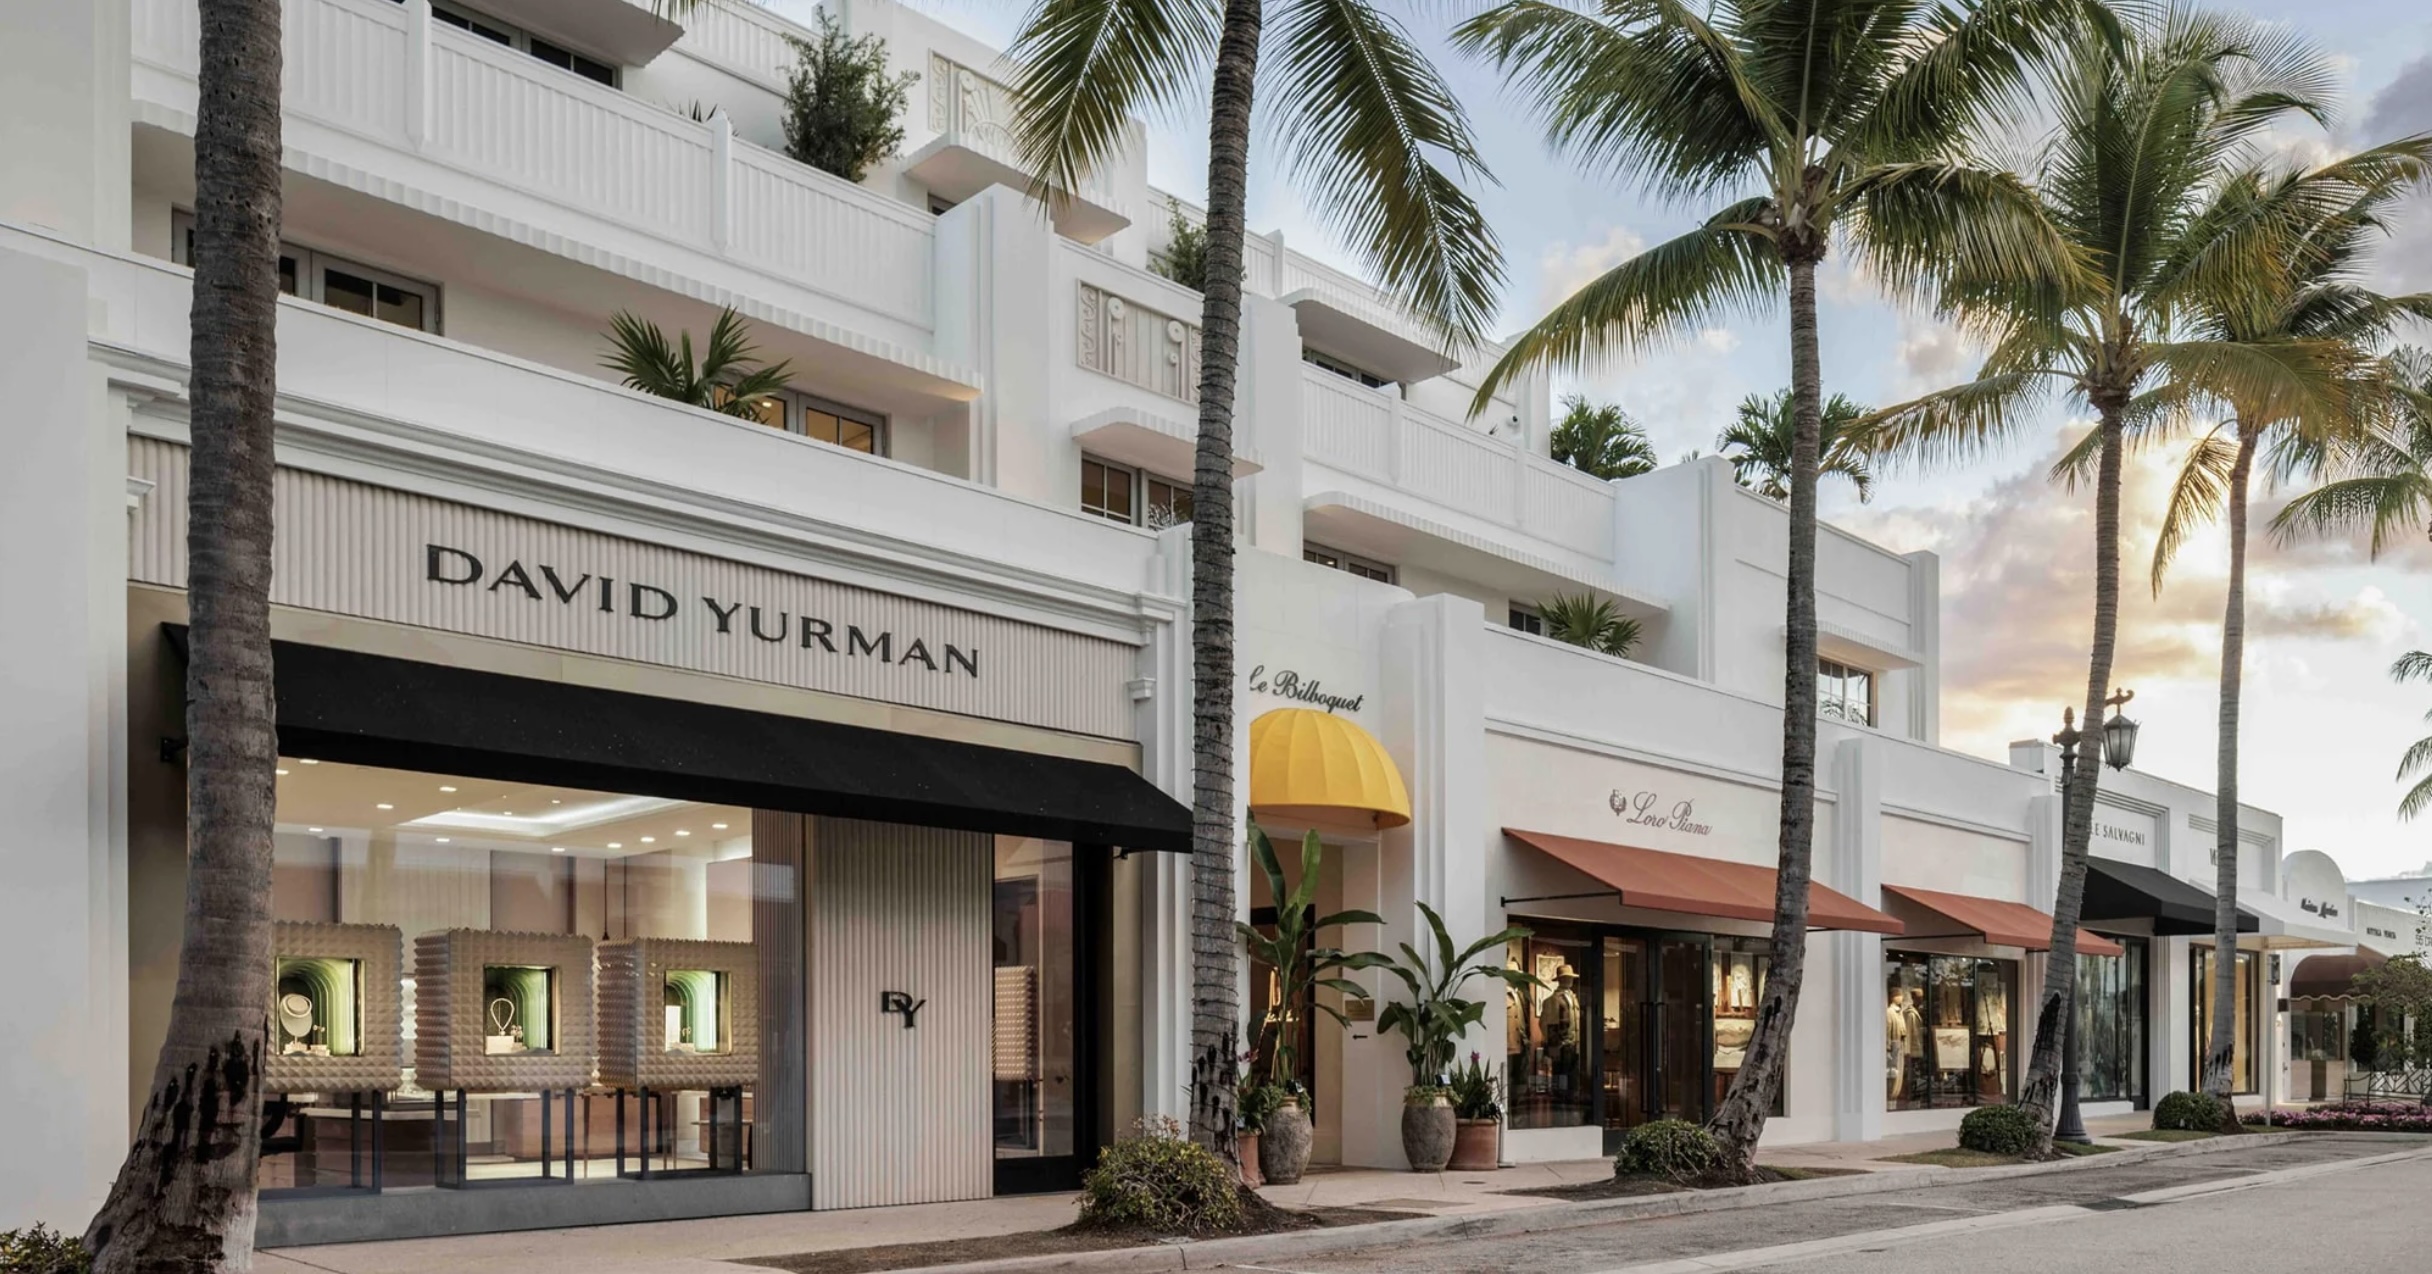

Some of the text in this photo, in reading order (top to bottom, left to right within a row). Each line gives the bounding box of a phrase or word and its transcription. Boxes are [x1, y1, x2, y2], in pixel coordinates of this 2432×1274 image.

[426, 543, 980, 679] DAVID YURMAN
[1249, 664, 1364, 714] Le Bilboquet
[1626, 791, 1713, 836] Loro Piana
[2102, 824, 2146, 846] SALVAGNI
